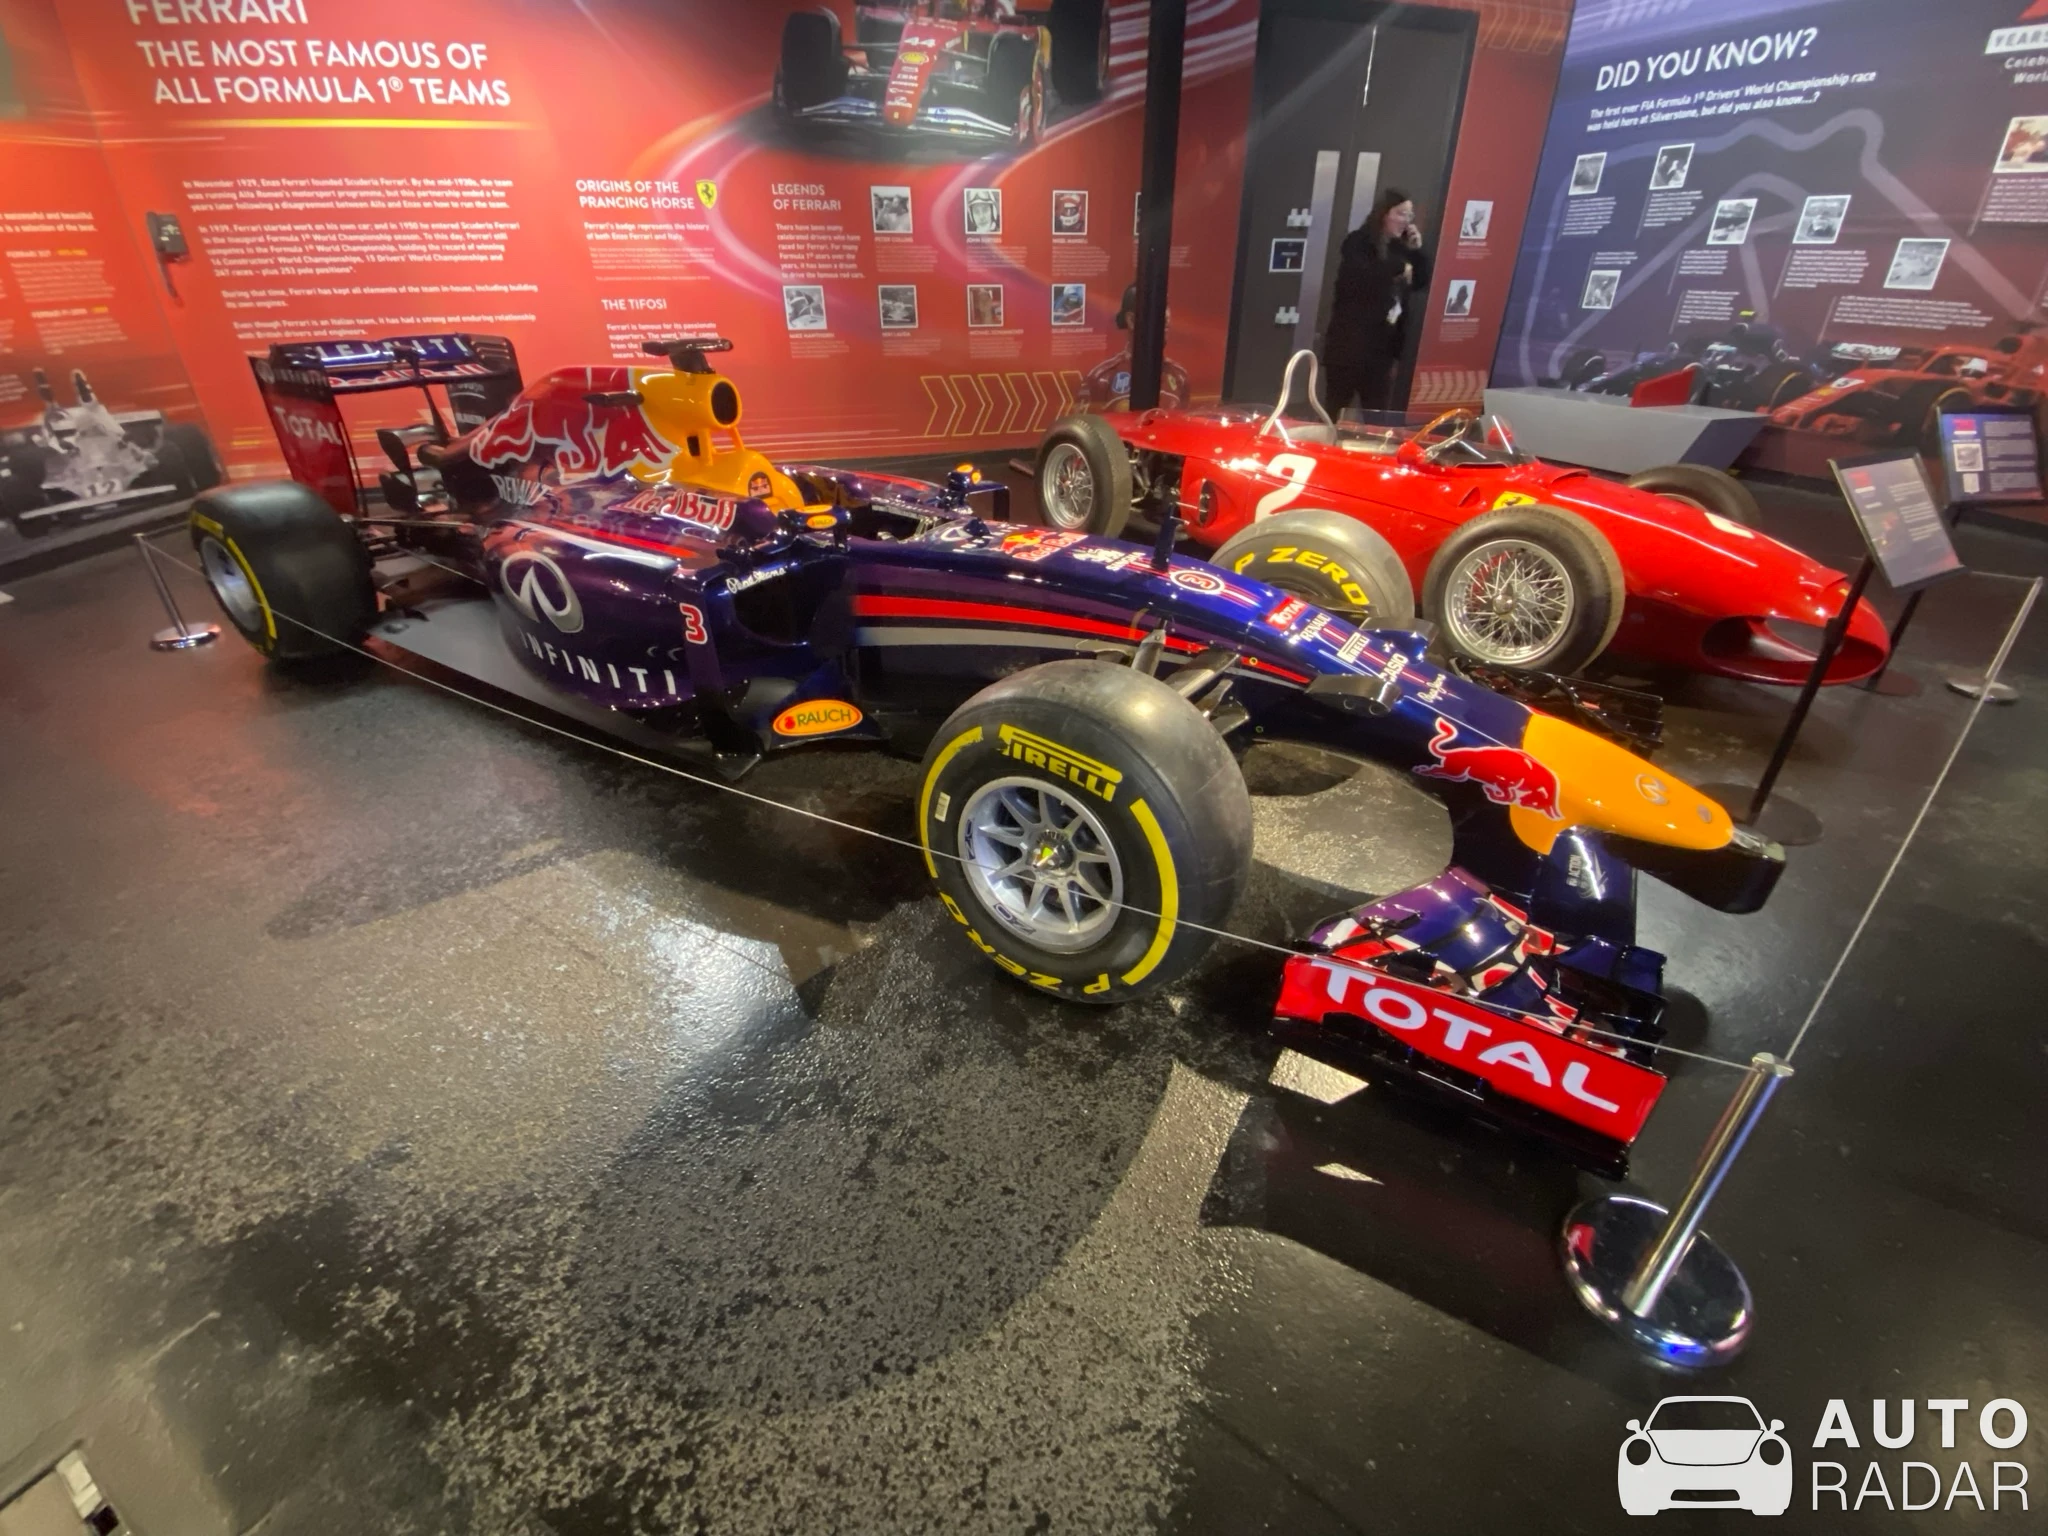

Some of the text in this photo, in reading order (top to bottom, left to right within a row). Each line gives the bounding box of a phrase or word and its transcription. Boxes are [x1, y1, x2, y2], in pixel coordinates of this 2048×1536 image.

[129, 0, 309, 25] FERRARI
[136, 40, 489, 71] THE MOST FAMOUS OF
[904, 37, 936, 48] 44
[1595, 27, 1818, 91] DID YOU KNOW?
[2004, 56, 2048, 69] Celeb
[154, 78, 211, 105] ALL
[216, 76, 375, 104] FORMULA
[408, 78, 511, 107] TEAMS
[576, 179, 679, 194] ORIGINS OF THE
[771, 184, 825, 196] LEGENDS
[579, 196, 695, 210] PRANCING HORSE
[773, 199, 842, 212] OF FERRARI
[602, 298, 667, 310] THE TIFOSI
[274, 405, 344, 446] TOTAL
[1255, 453, 1317, 524] 2
[1267, 547, 1370, 607] ZERO
[679, 603, 708, 645] 3
[1267, 599, 1307, 628] TOTAL
[1298, 612, 1332, 643] RENAULT
[519, 630, 677, 696] INFINITI
[1336, 632, 1371, 664] PIRELLI
[1379, 652, 1409, 683] CASIO
[796, 708, 852, 728] RAUCH
[997, 723, 1123, 802] PIRELLI
[939, 889, 1111, 995] P ZERO
[1310, 960, 1620, 1114] TOTAL
